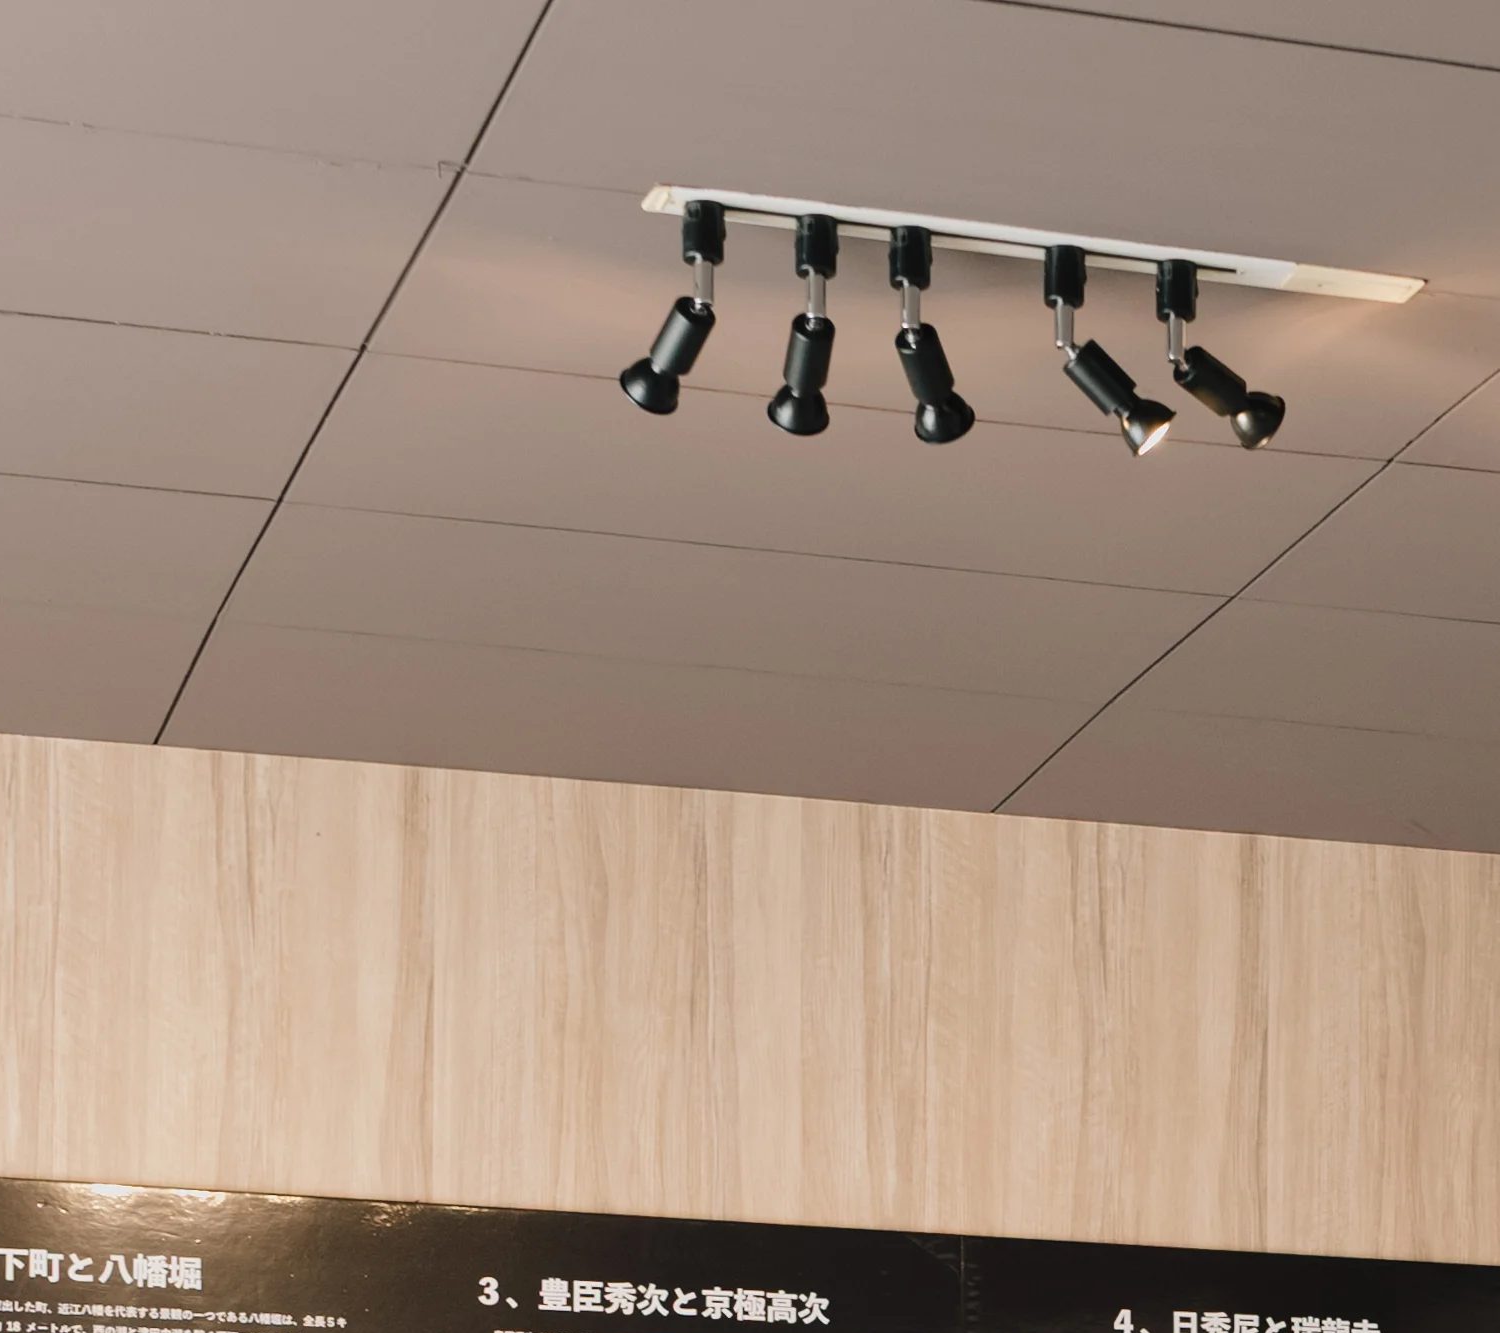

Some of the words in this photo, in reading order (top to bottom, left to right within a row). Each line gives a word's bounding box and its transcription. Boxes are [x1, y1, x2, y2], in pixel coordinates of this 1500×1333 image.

[478, 1273, 829, 1325] 3、豊臣秀次と京極高次
